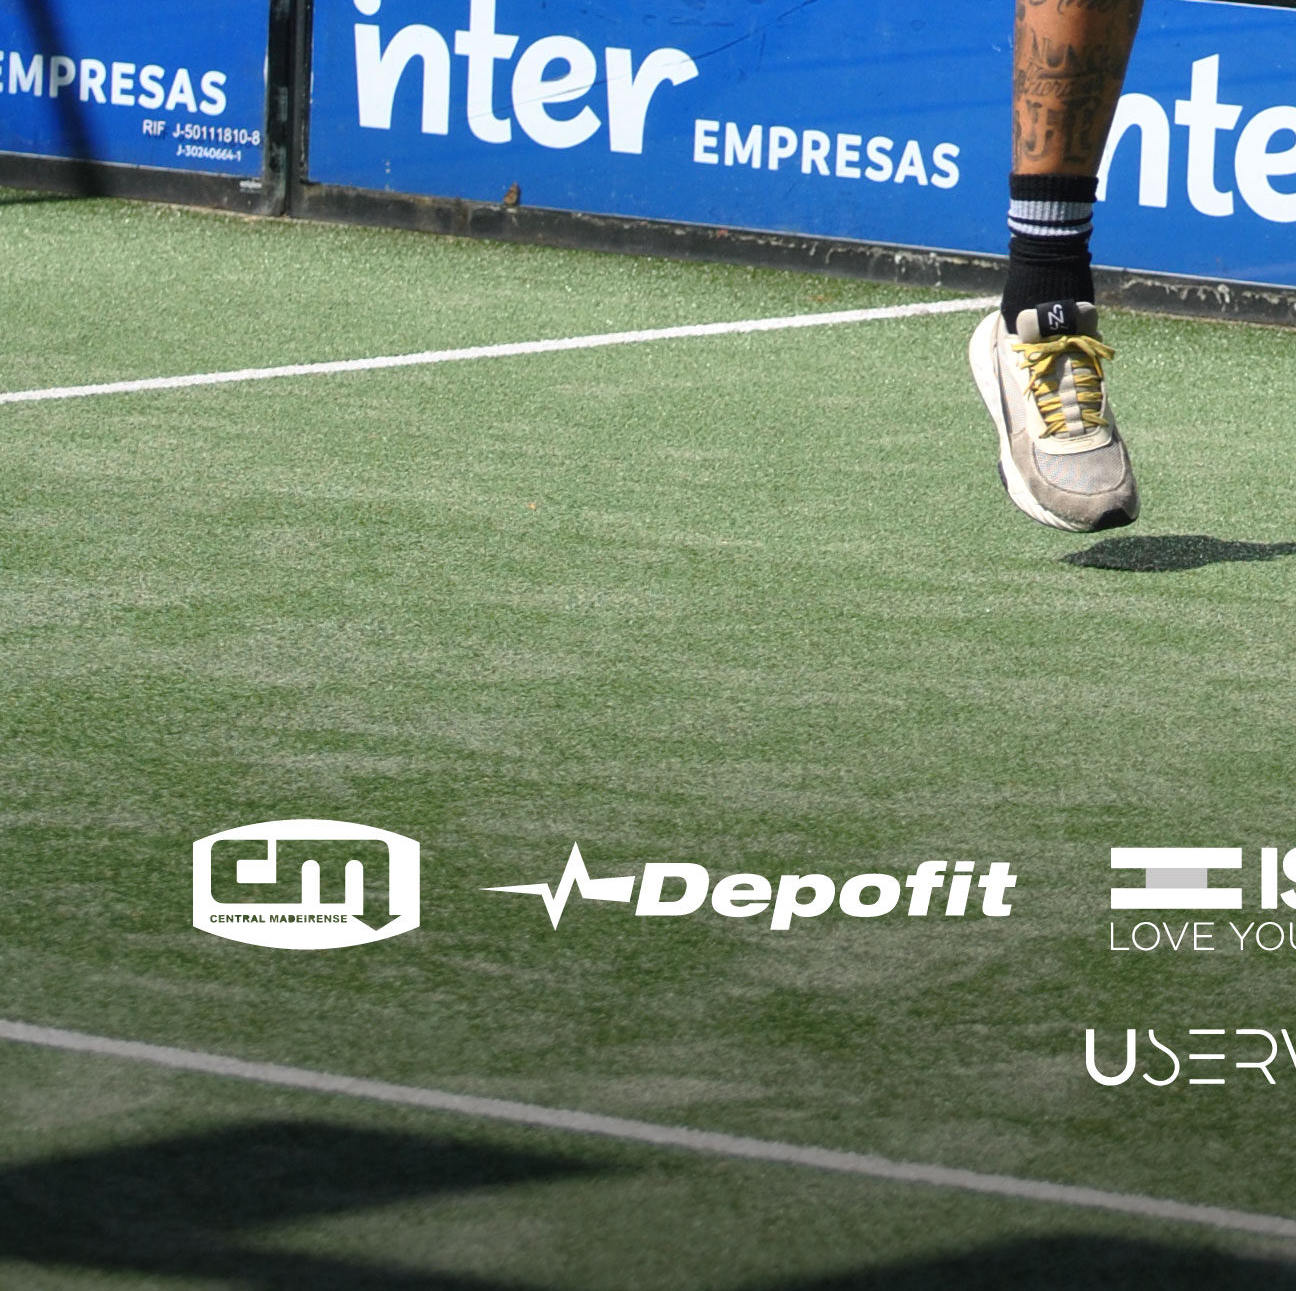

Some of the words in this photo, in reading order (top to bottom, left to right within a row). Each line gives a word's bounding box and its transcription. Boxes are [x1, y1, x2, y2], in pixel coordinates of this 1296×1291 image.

[0, 49, 228, 117] MPRESAS
[142, 118, 167, 137] RIF
[172, 122, 261, 146] J-50111810-8
[693, 118, 962, 191] EMPRESAS
